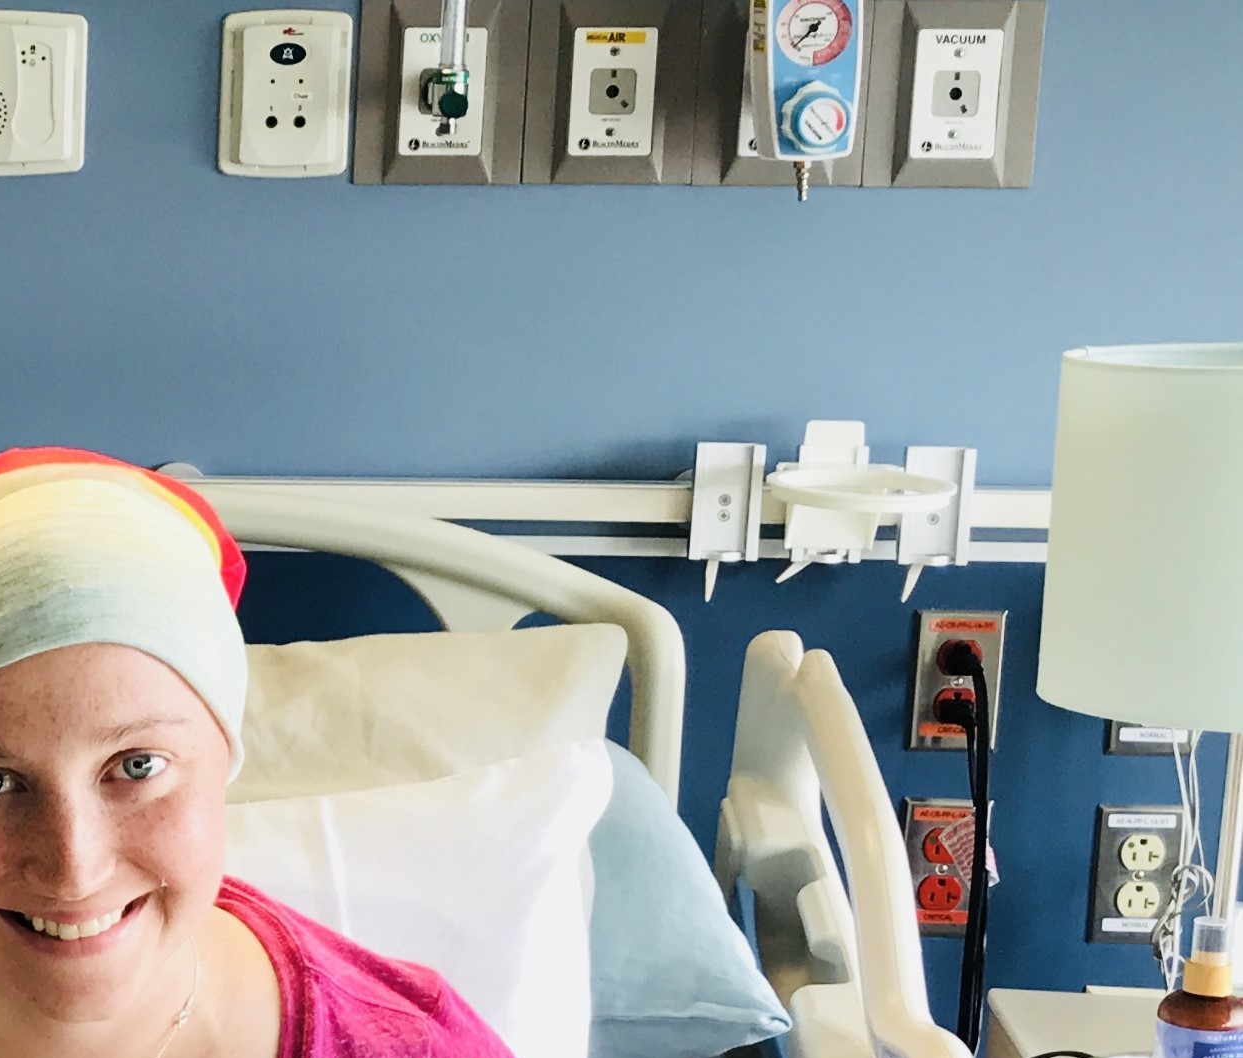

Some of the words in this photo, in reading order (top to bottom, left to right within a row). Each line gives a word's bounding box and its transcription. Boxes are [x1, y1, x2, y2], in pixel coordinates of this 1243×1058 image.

[608, 31, 626, 42] AIR
[936, 34, 987, 45] VACUUM
[1121, 921, 1149, 929] NORMAL
